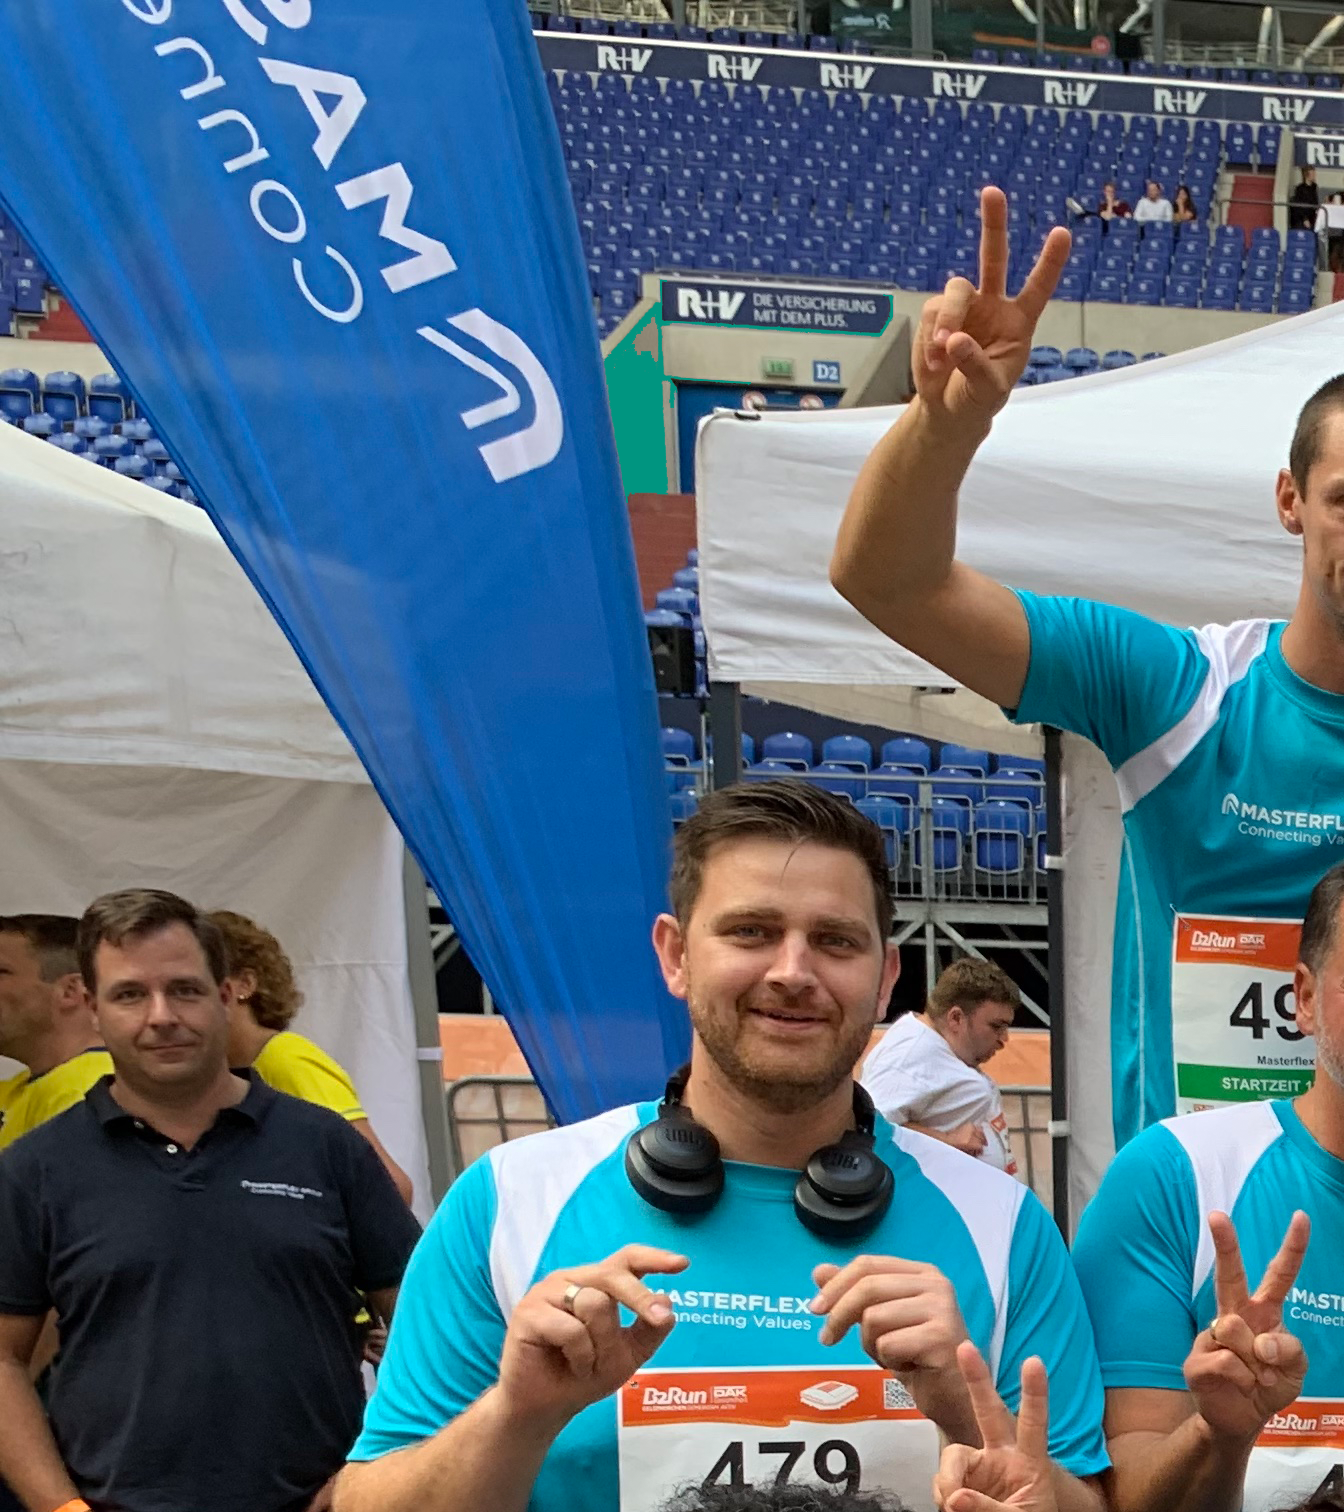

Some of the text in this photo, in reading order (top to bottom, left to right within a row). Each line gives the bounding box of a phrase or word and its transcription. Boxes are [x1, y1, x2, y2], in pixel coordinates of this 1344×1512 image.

[597, 45, 652, 73] R+V
[820, 62, 875, 89] R+V
[1044, 80, 1097, 106] R+V
[1263, 96, 1315, 123] R+V
[677, 288, 746, 320] R+V
[752, 293, 876, 315] DIE VERSICHERUNG
[754, 308, 848, 328] MIT DEM PLUS.
[816, 363, 839, 380] D2
[1238, 821, 1321, 846] Connecting
[1257, 1055, 1315, 1068] Masterflex
[754, 1316, 811, 1331] Values
[702, 1439, 861, 1494] 479
